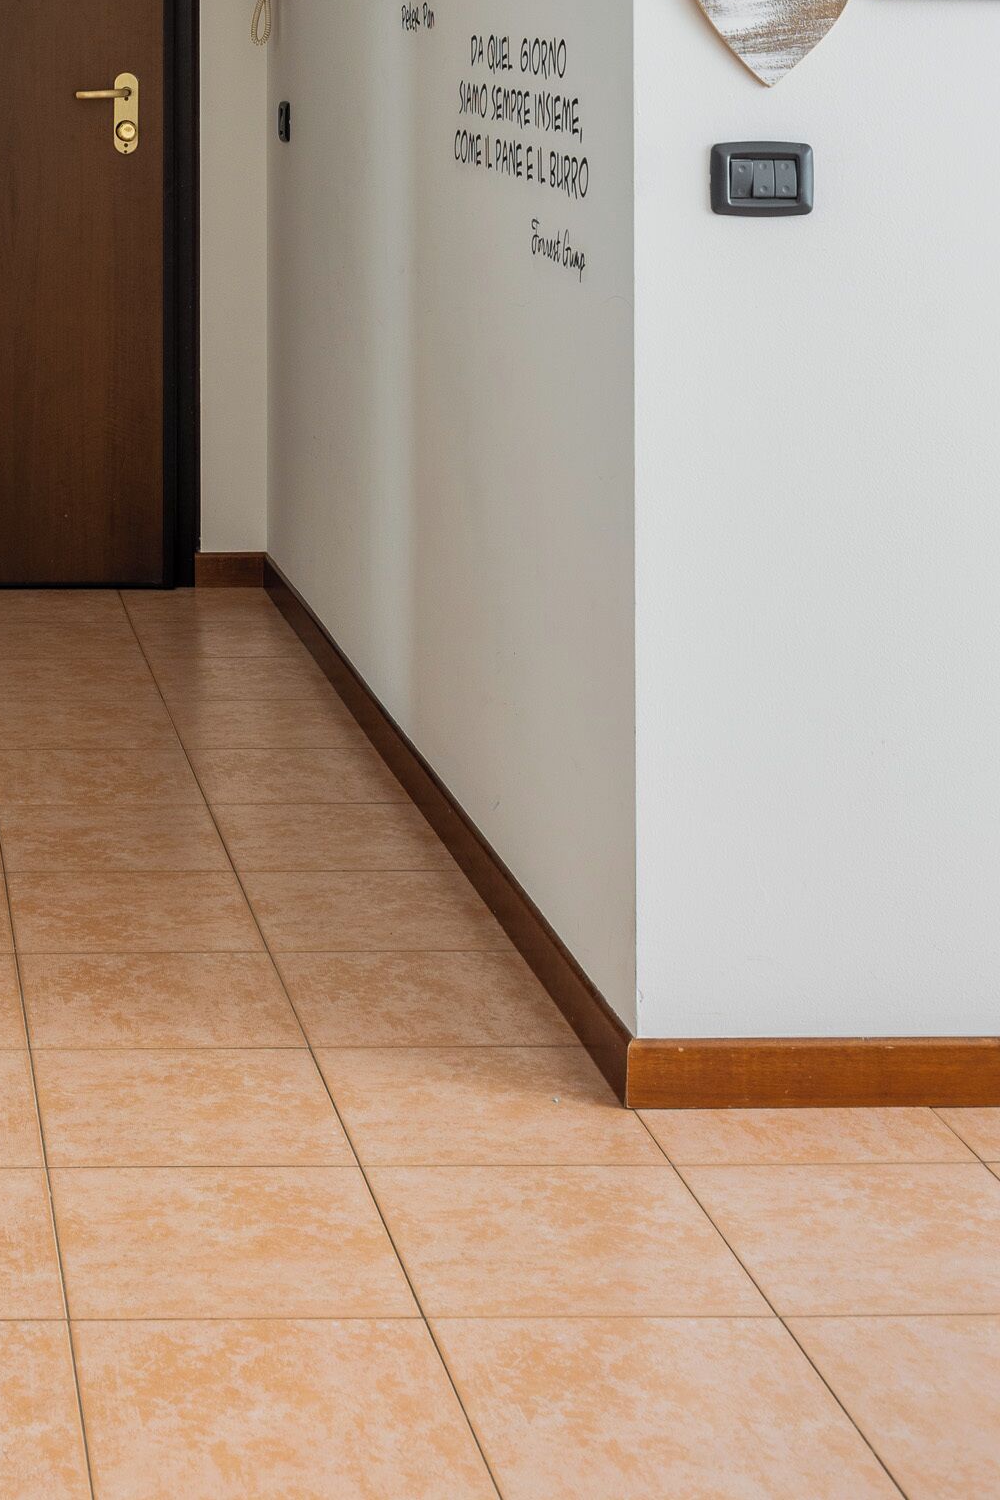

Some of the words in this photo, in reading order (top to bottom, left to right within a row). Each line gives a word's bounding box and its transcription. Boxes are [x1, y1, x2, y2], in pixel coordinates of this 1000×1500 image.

[470, 34, 484, 67] DA
[487, 33, 514, 76] QUEL
[519, 37, 568, 80] GIORNO
[458, 79, 489, 119] SIAMO
[490, 86, 531, 130] SEMPRE
[534, 90, 584, 144] INSIEME,
[454, 129, 482, 167] COME
[485, 135, 493, 169] IL
[495, 138, 524, 178] PANE
[526, 145, 534, 182] E
[537, 147, 546, 185] IL
[549, 150, 590, 200] BURRO
[530, 217, 563, 263] Forrest
[561, 228, 587, 283] Gump
